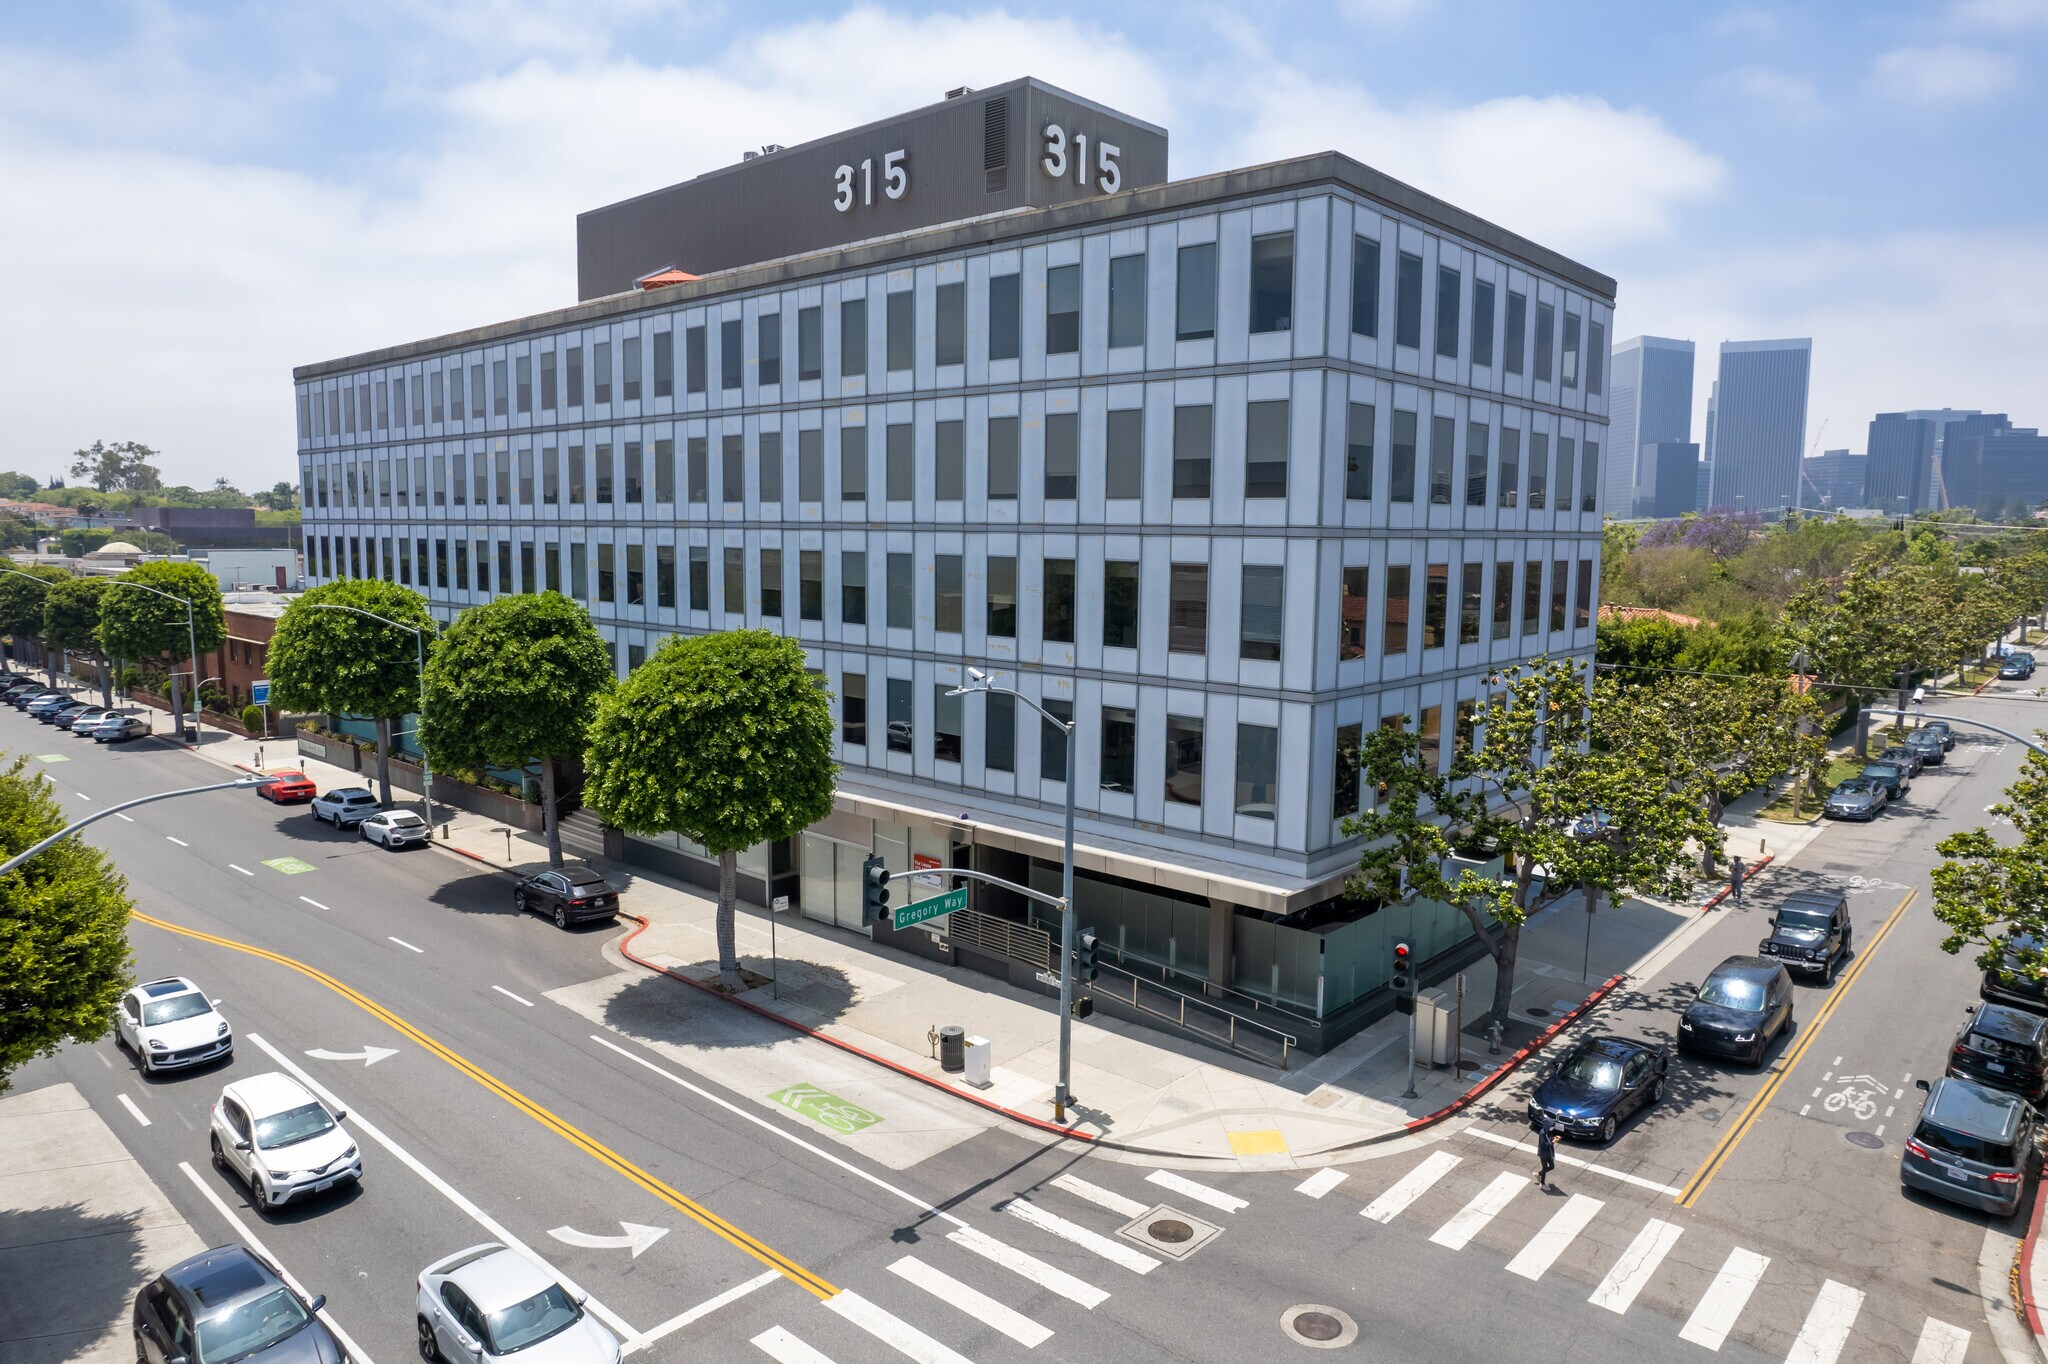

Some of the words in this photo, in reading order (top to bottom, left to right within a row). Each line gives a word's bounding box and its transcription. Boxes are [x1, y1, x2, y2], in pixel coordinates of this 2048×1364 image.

[833, 148, 908, 212] 315
[1042, 124, 1121, 195] 315
[899, 903, 939, 924] Gregory
[944, 896, 963, 909] Way
